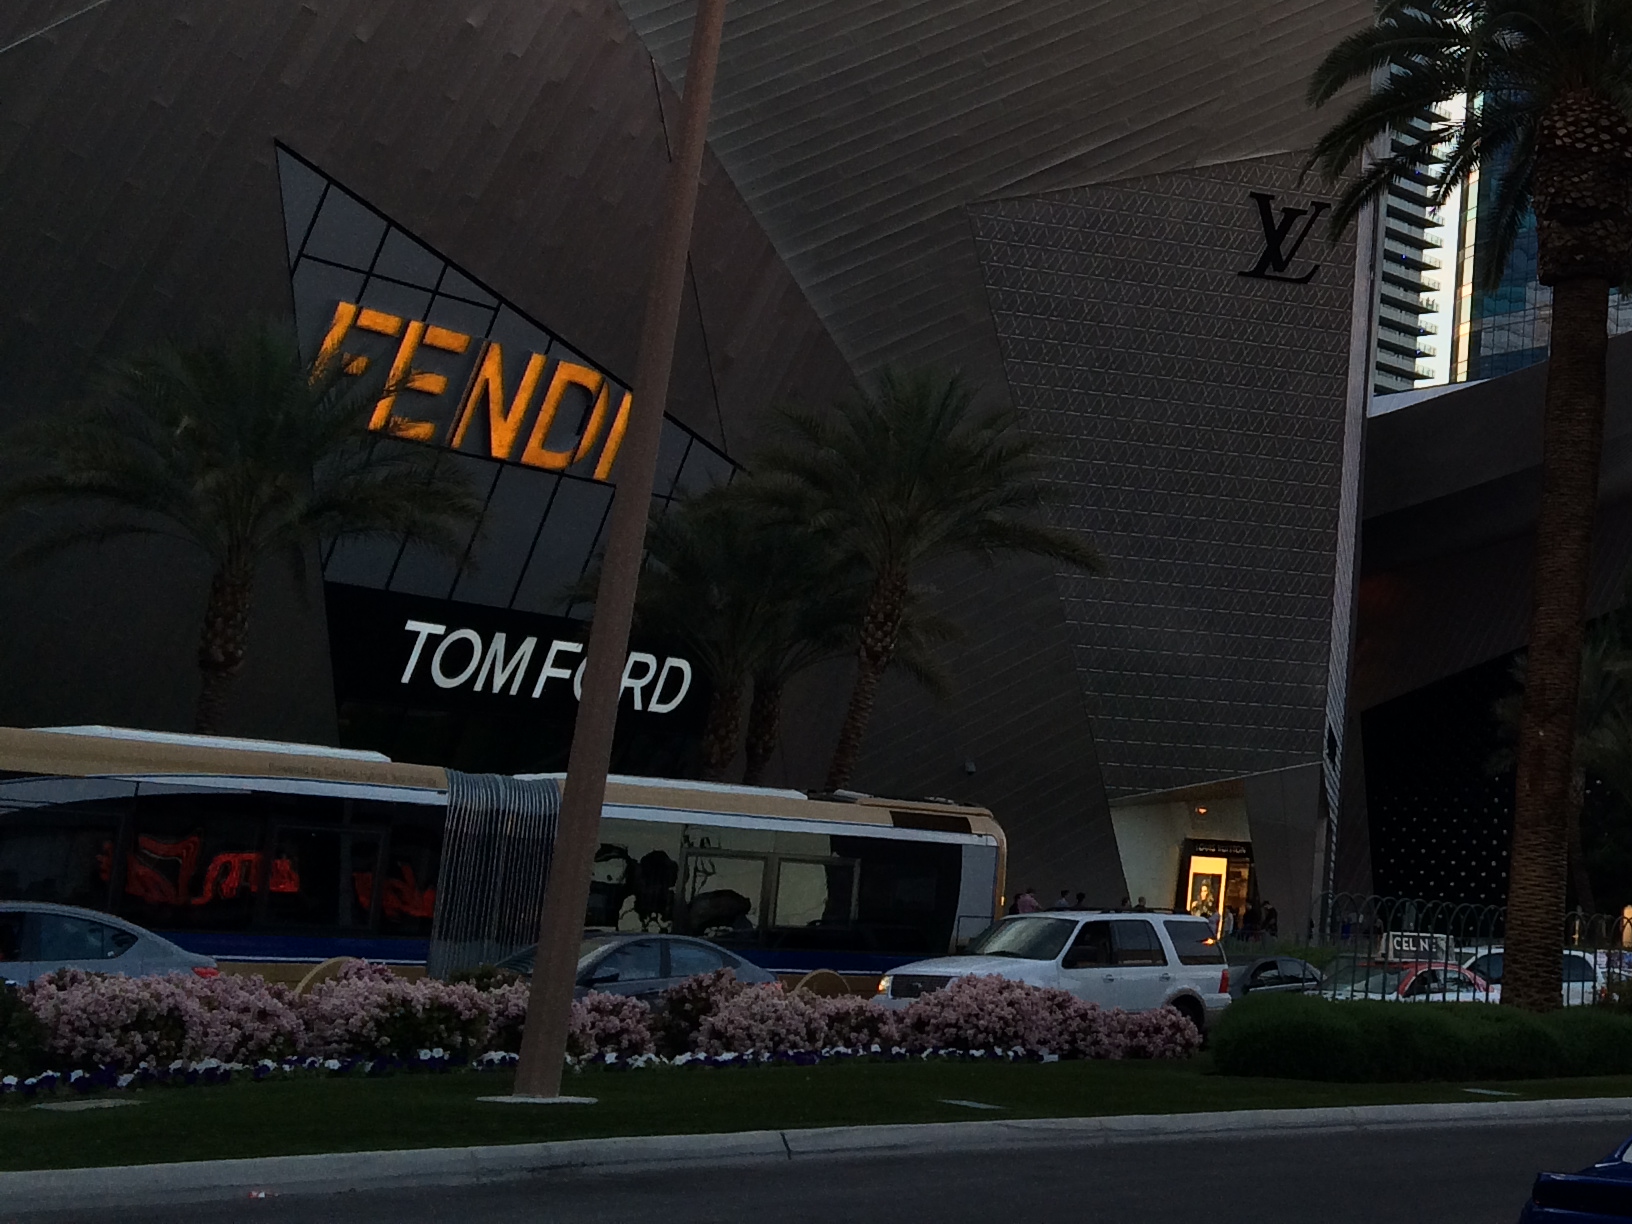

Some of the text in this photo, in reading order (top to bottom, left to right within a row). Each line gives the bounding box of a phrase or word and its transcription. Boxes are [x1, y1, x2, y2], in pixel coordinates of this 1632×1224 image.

[307, 301, 634, 482] FENDI
[400, 619, 692, 714] TOM FRD
[1393, 937, 1436, 952] CELNE
